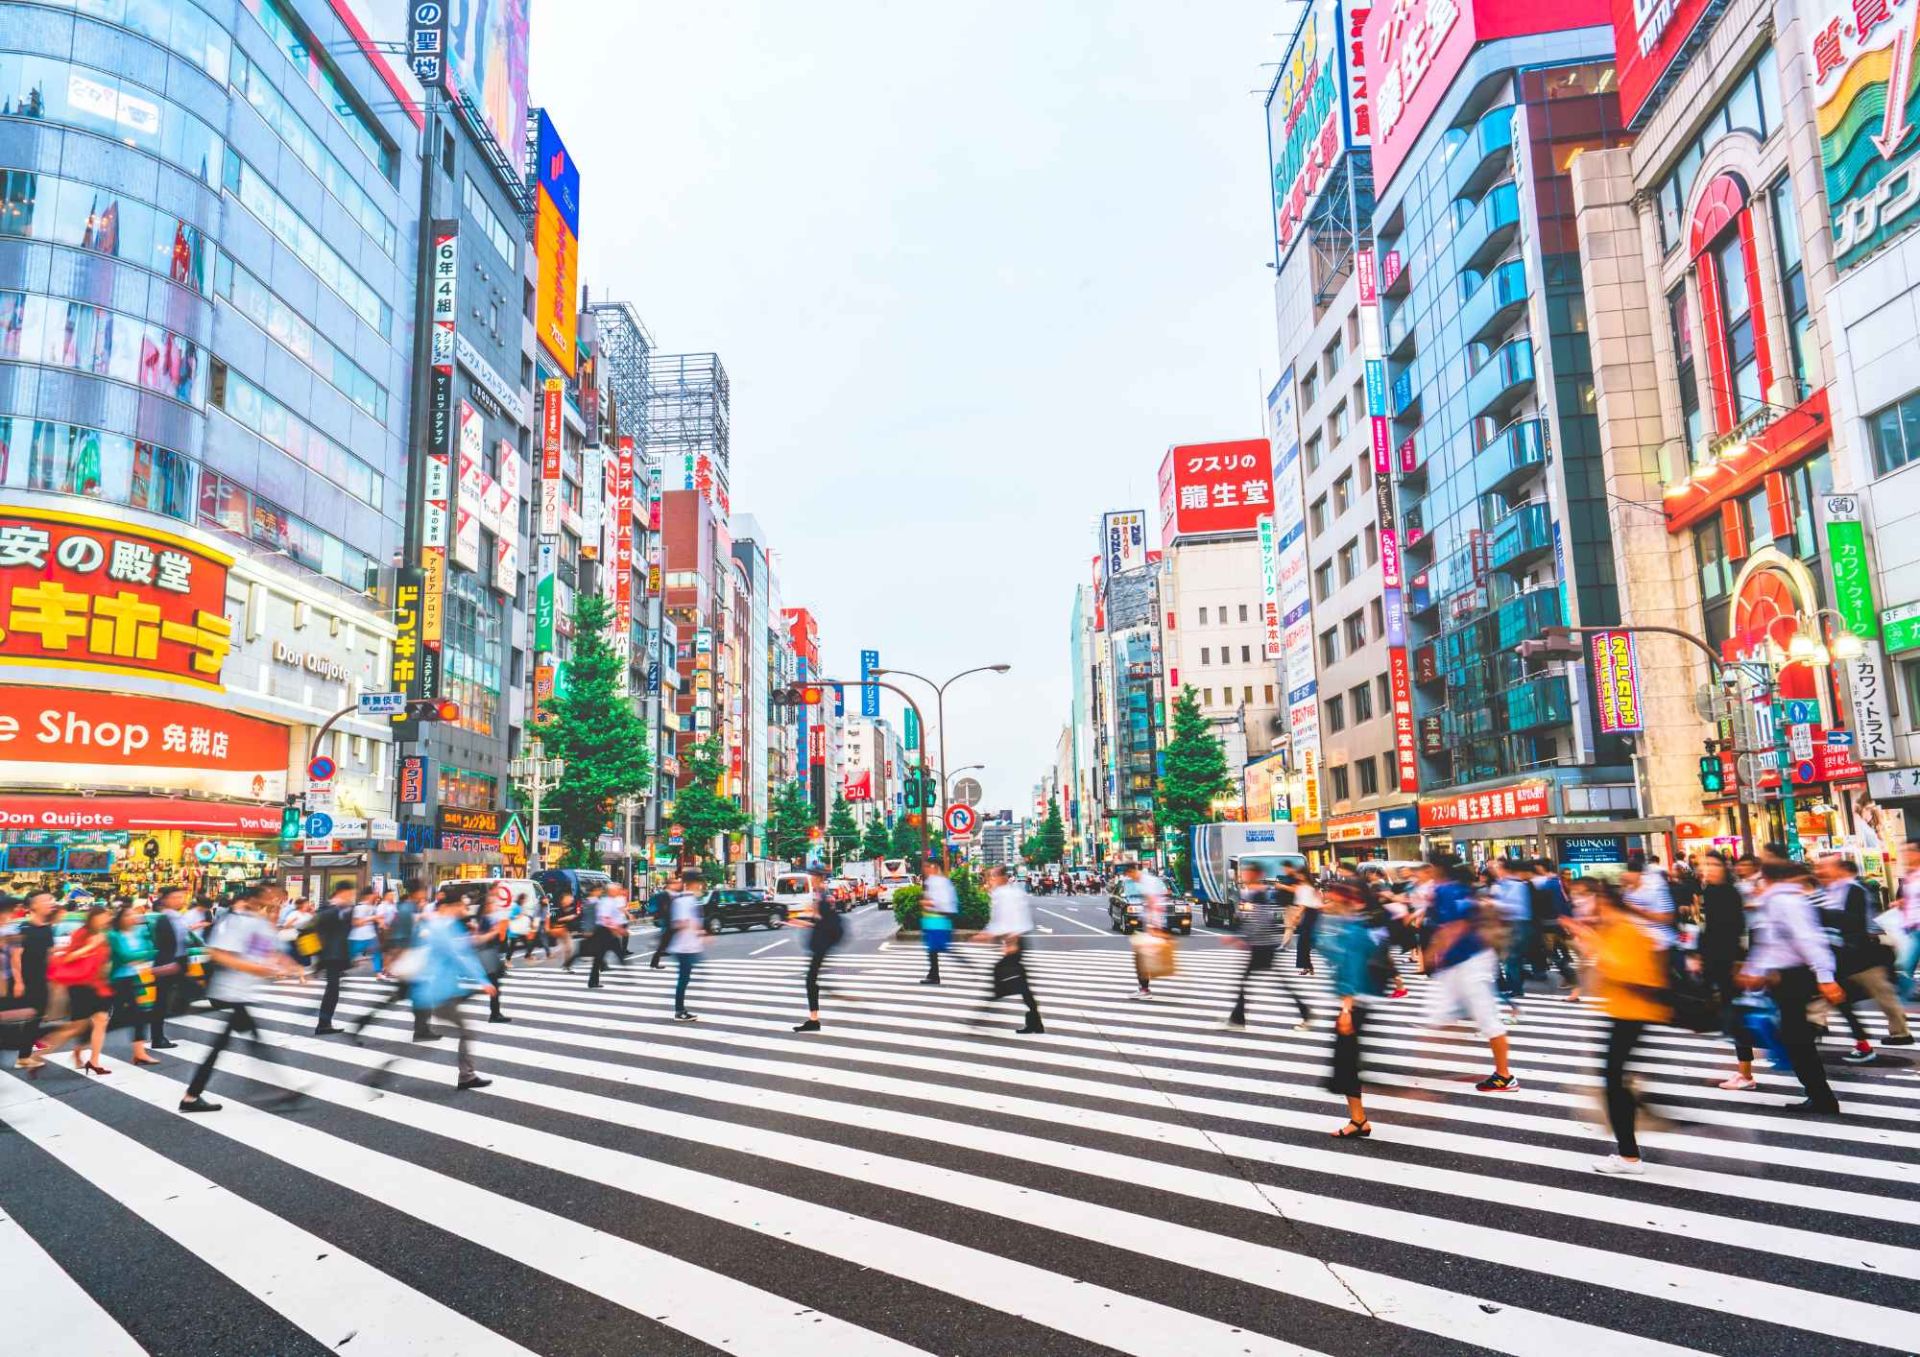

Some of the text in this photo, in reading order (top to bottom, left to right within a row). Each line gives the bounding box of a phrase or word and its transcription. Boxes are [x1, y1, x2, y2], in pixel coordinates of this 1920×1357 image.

[618, 446, 632, 507] カラオケ
[1187, 454, 1256, 474] クスリの
[1180, 479, 1269, 510] 龍生堂
[427, 557, 437, 629] アラビアンロック
[538, 596, 550, 629] レイク
[1886, 611, 1898, 621] 3F
[278, 641, 350, 680] Don Quijote
[1858, 663, 1886, 758] カワノ・トラスト
[36, 710, 149, 755] Shop
[162, 723, 229, 759] 免税店
[41, 811, 114, 826] Quijote
[240, 817, 258, 830] Don
